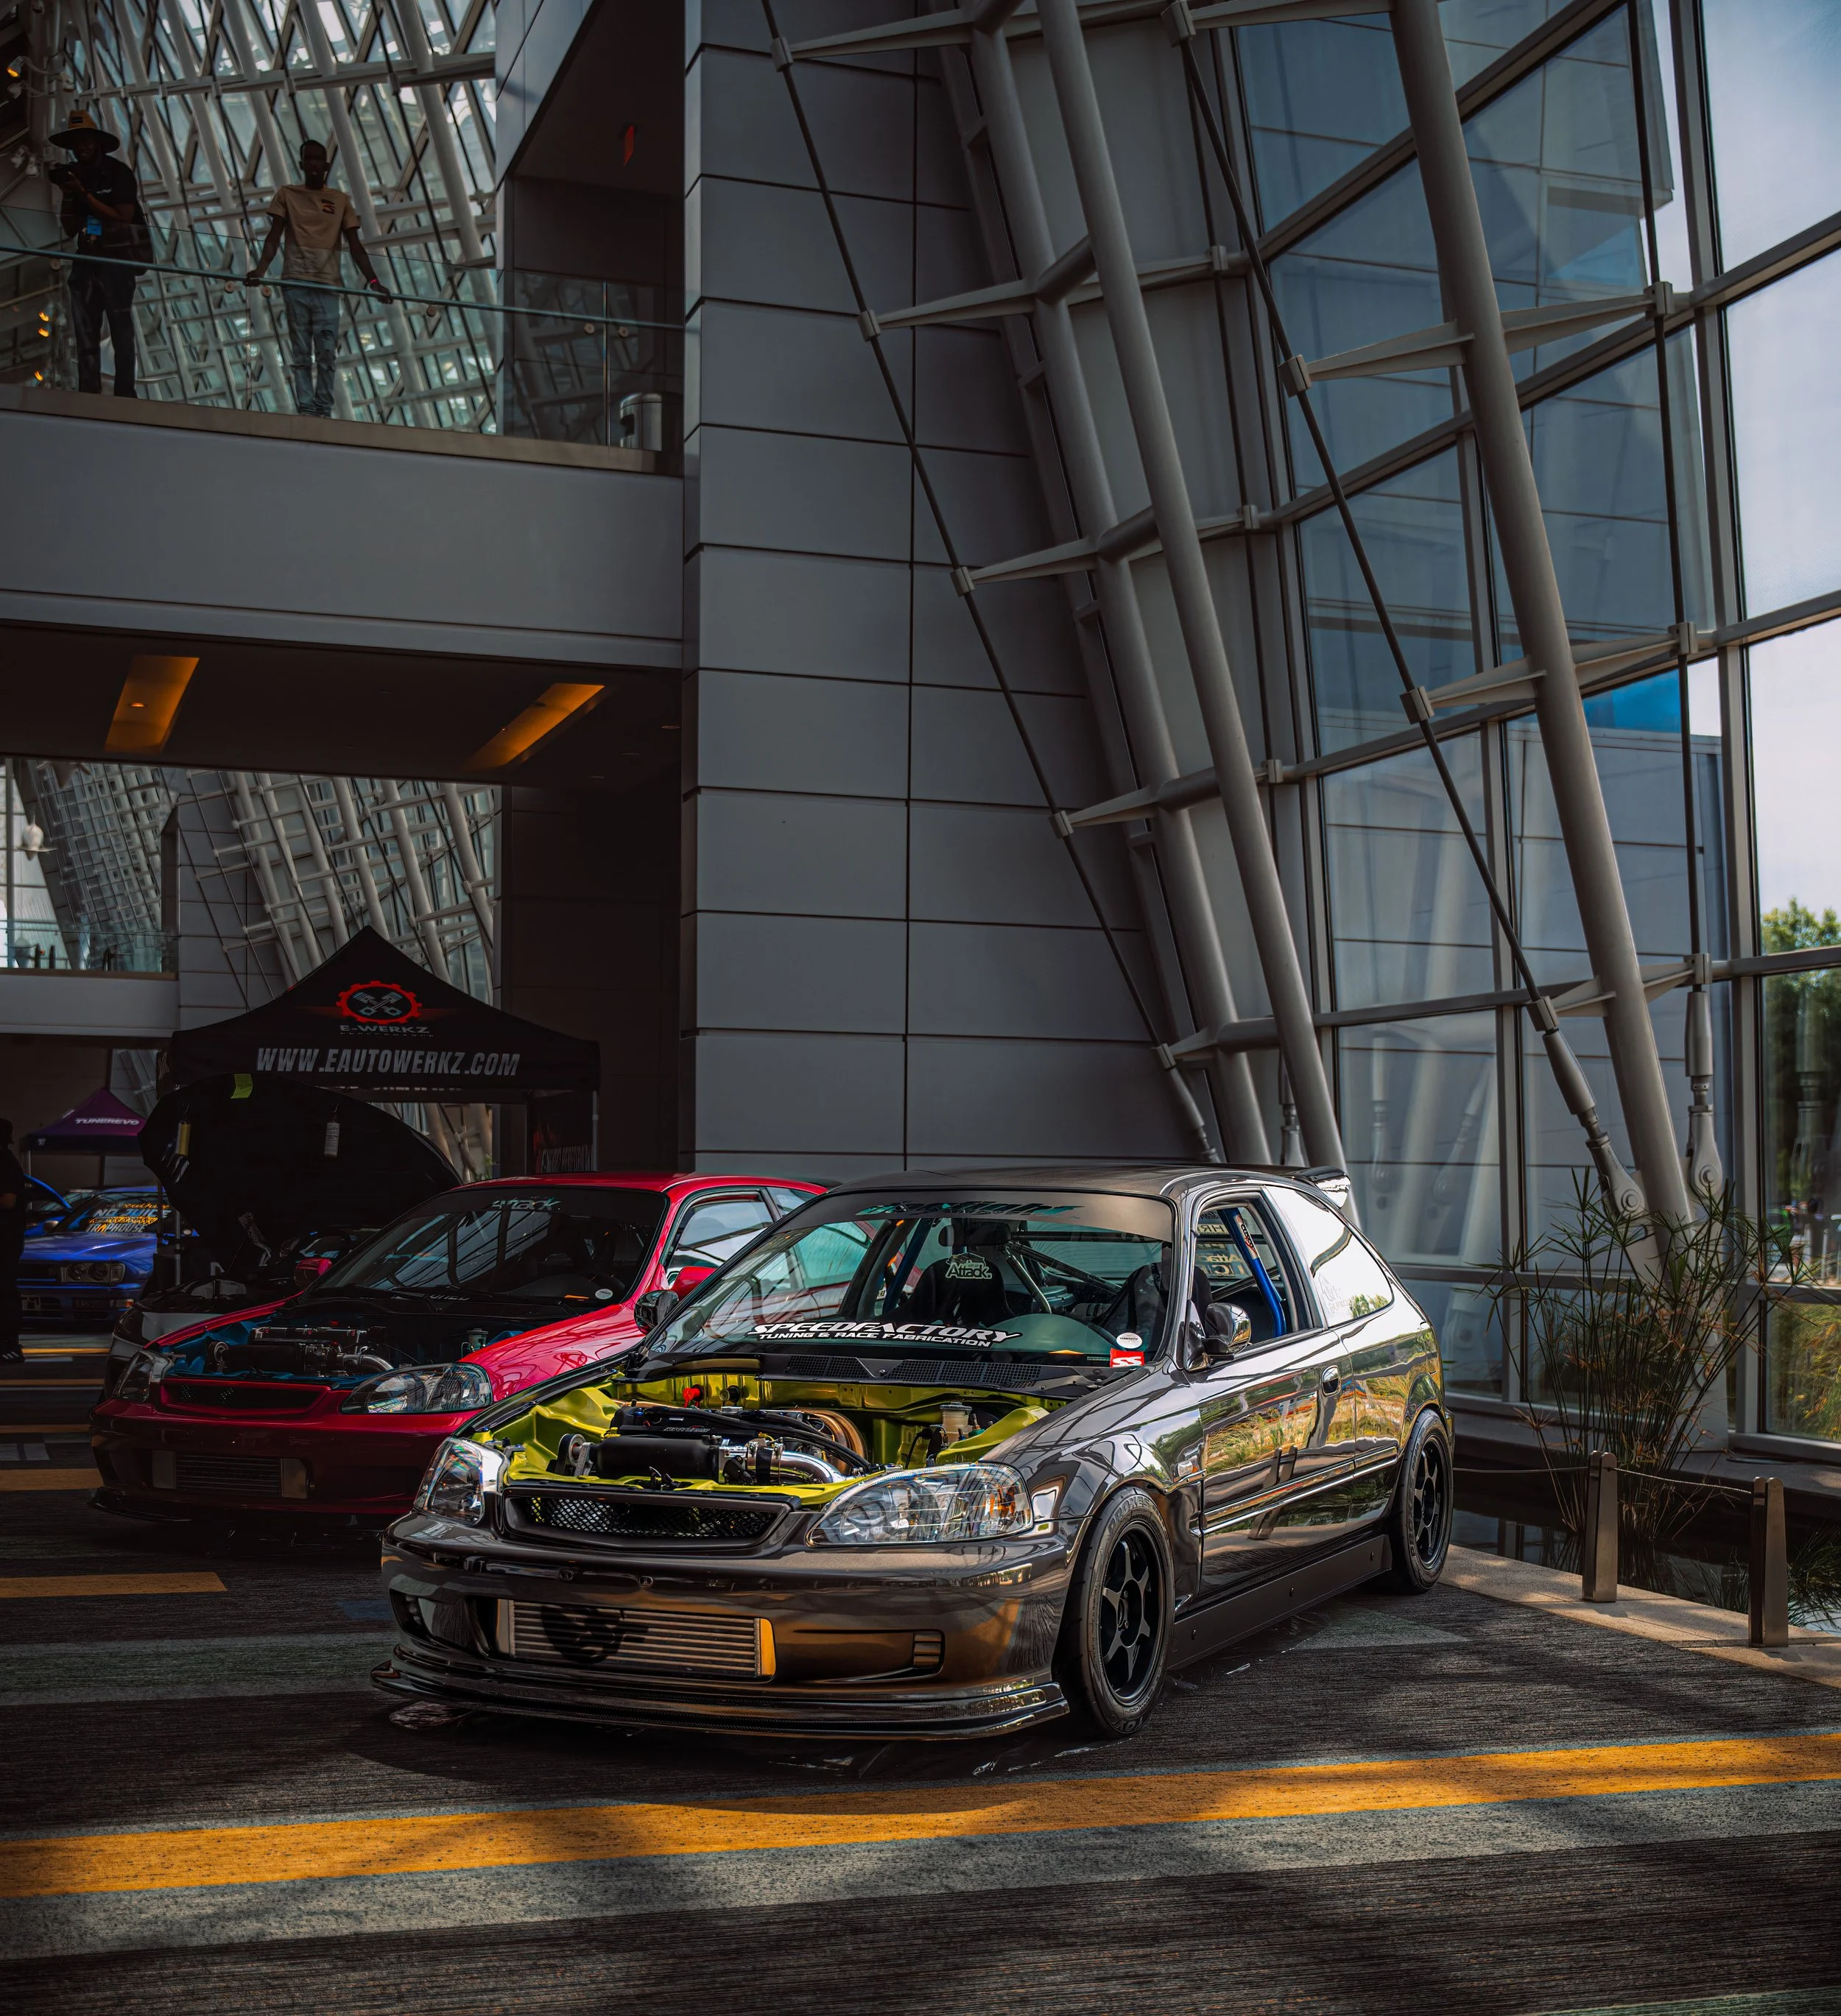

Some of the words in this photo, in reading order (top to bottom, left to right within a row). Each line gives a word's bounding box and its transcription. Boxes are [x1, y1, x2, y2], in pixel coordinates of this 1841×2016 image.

[339, 1024, 430, 1033] E-WERKZ
[256, 1047, 521, 1076] WWW.EAUTOWERKZ.COM
[747, 1322, 1021, 1342] SPEEDFACTORY
[836, 1331, 876, 1339] RACE
[881, 1333, 991, 1347] FABRICATION
